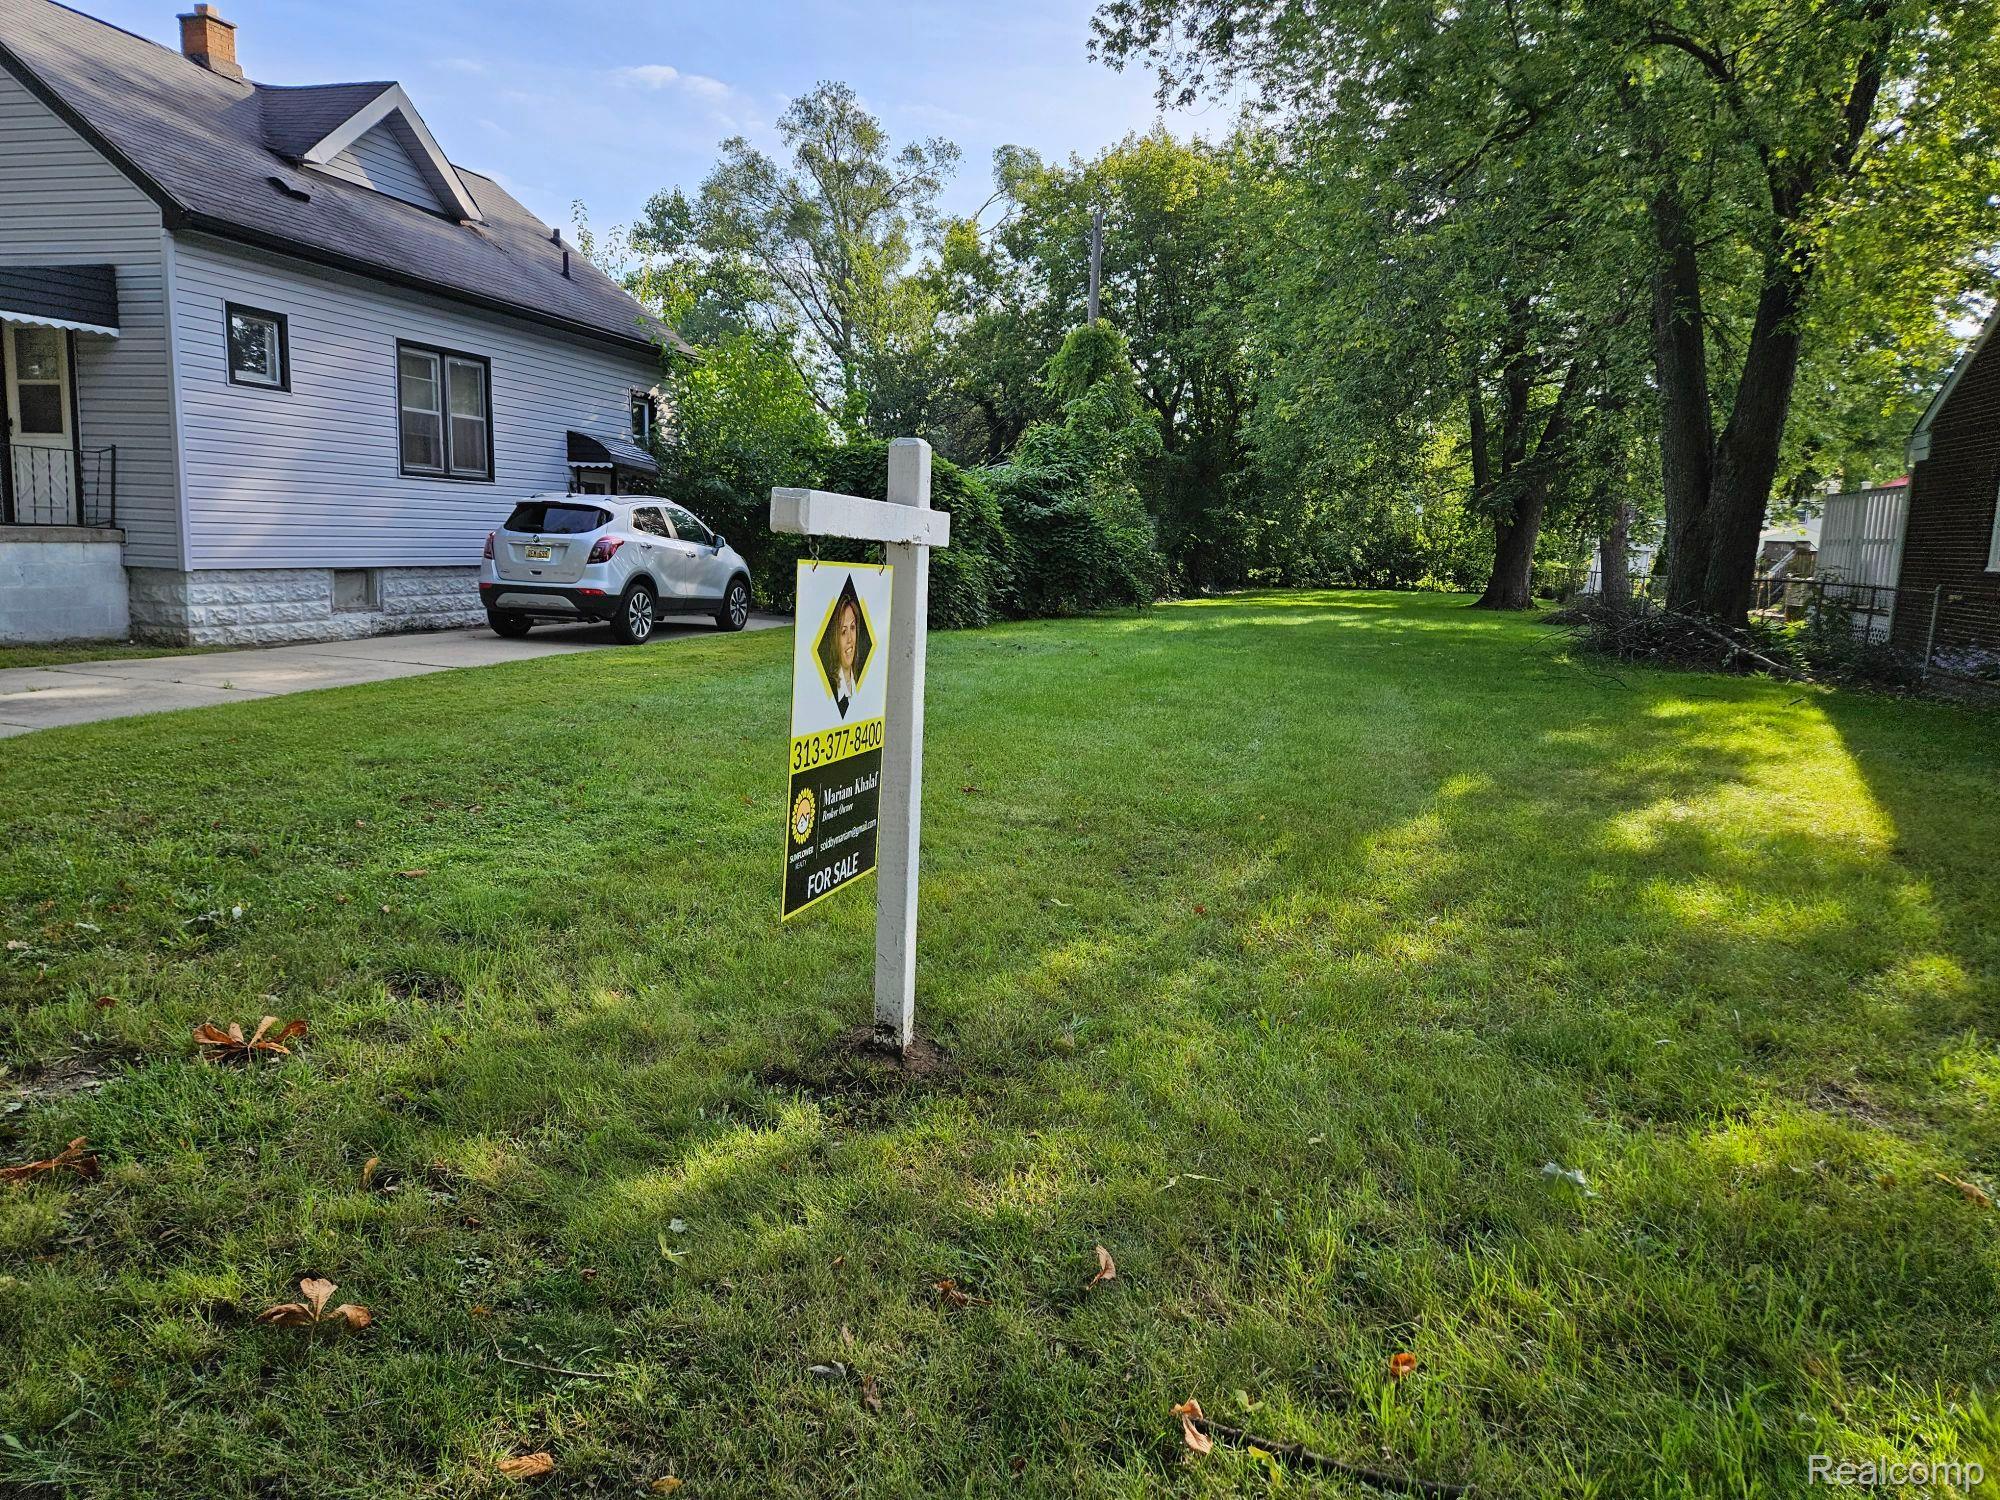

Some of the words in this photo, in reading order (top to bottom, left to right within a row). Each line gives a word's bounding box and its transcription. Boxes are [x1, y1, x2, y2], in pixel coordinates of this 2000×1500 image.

[793, 720, 883, 771] 313-377-8400
[823, 784, 854, 807] Mariam
[854, 770, 880, 796] Khalaf
[789, 845, 814, 864] SUNFLOWER
[807, 866, 832, 899] FOR
[833, 851, 860, 884] SALE
